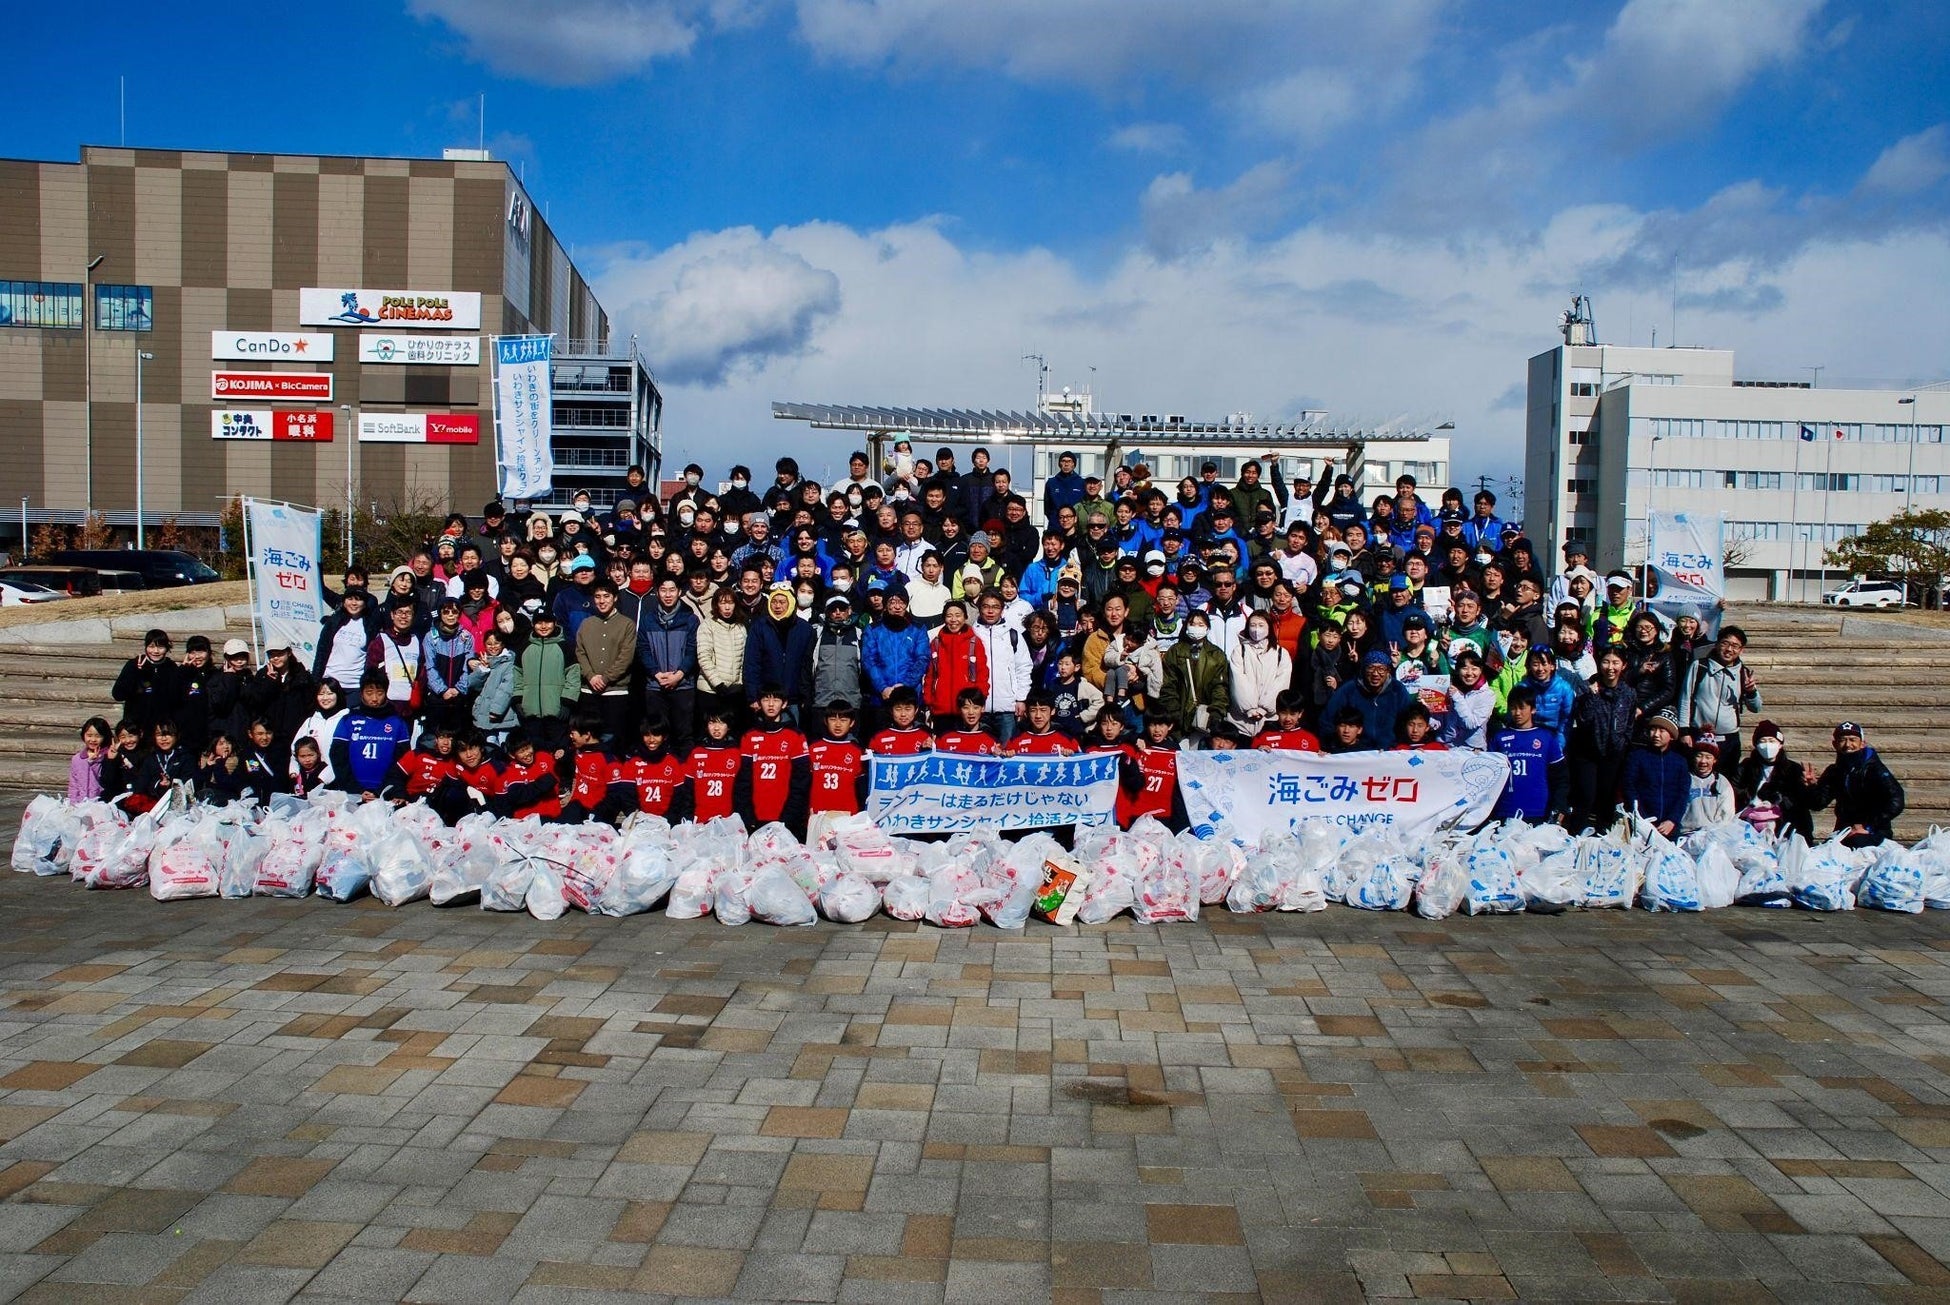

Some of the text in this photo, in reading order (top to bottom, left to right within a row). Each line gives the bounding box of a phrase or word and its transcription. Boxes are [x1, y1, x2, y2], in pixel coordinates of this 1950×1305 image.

[383, 296, 449, 309] POLE POLE
[378, 306, 453, 321] CINEMAS
[236, 338, 290, 353] CanDo
[407, 340, 472, 351] ひかりのテラス
[407, 351, 471, 361] 歯科クリニック
[229, 380, 273, 390] KOJIMA
[281, 381, 328, 391] BicCamera
[233, 414, 253, 425] 中央
[222, 425, 262, 437] コンタクト
[378, 423, 421, 434] SoftBank
[263, 547, 311, 572] 海ごみ
[1661, 551, 1713, 570] 海ごみ
[276, 571, 307, 591] ゼロ
[362, 743, 377, 759] 41
[761, 763, 777, 779] 22
[1513, 759, 1527, 776] 31
[707, 780, 723, 796] 28
[823, 772, 839, 789] 33
[1146, 776, 1163, 792] 27
[1268, 772, 1420, 805] 海ごみゼロ
[645, 786, 661, 802] 24
[879, 790, 1089, 810] ランナーは走るだけじゃない
